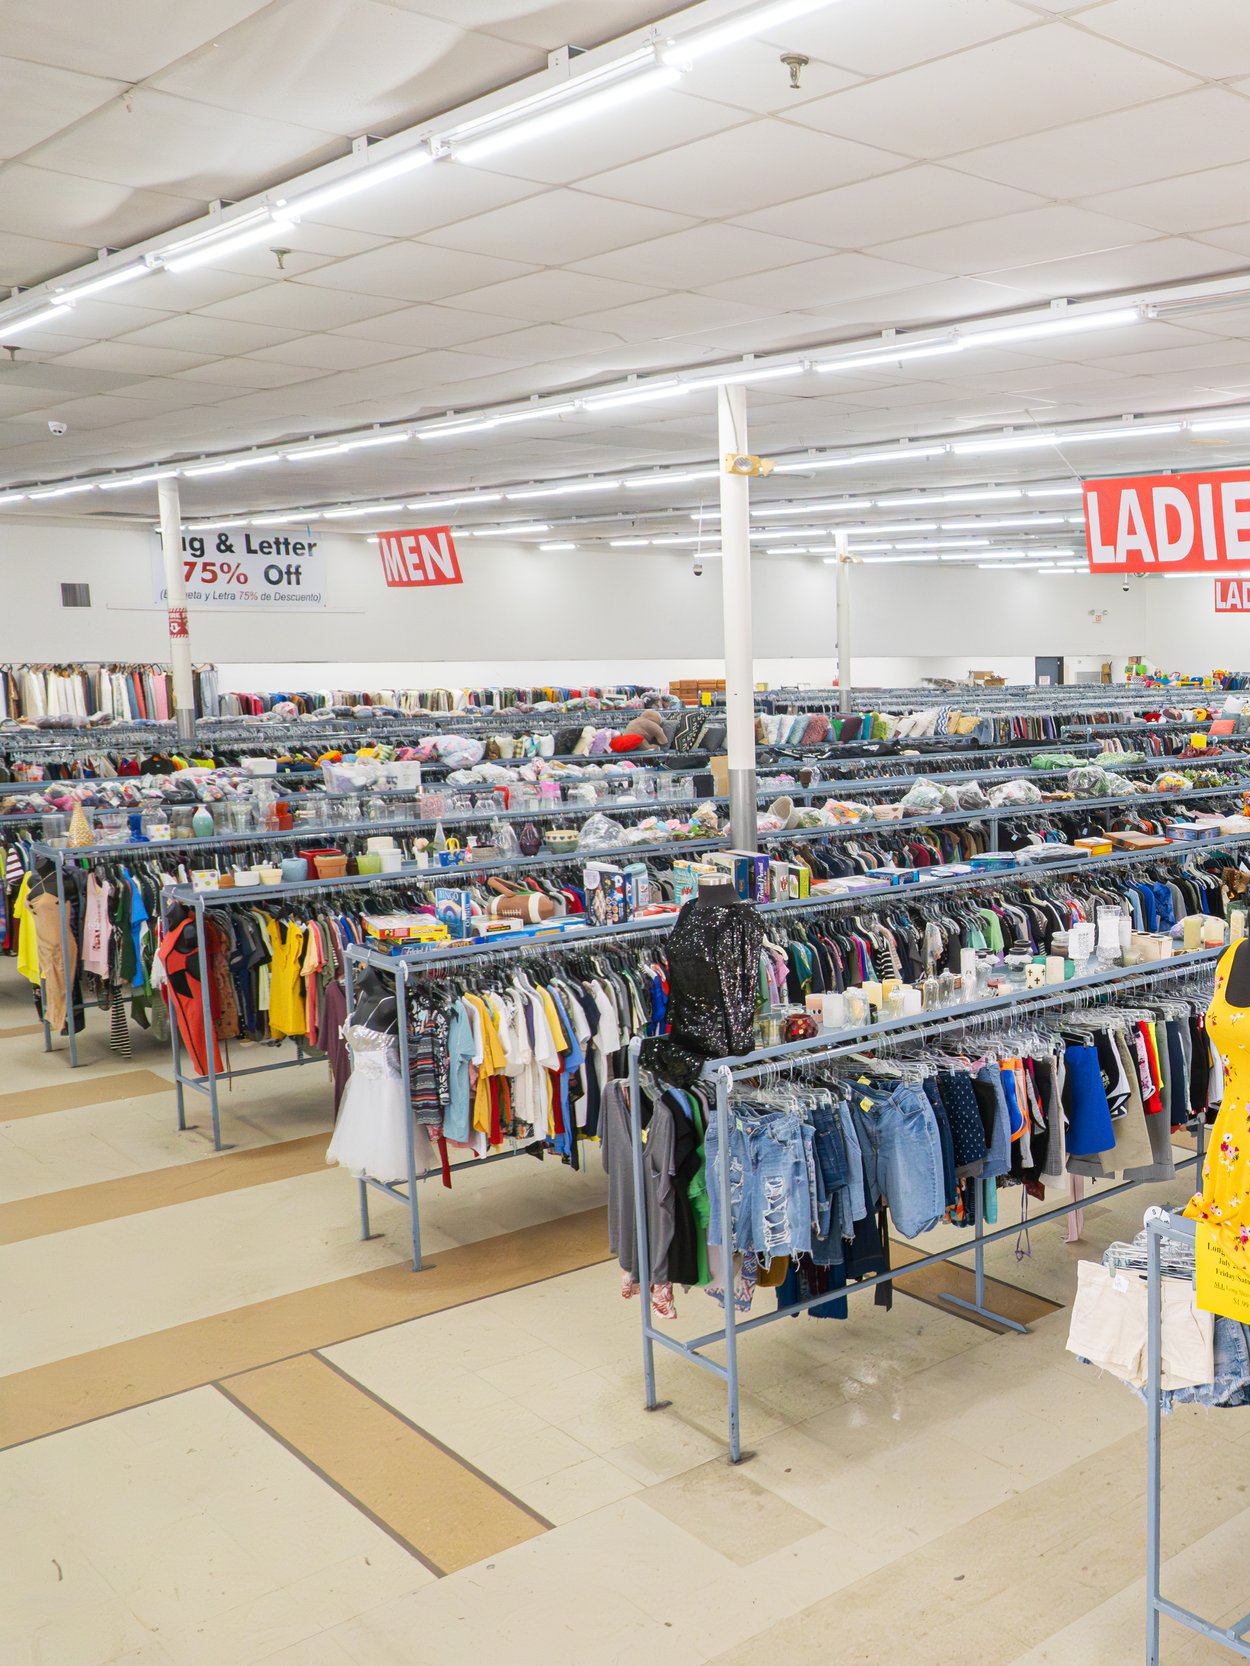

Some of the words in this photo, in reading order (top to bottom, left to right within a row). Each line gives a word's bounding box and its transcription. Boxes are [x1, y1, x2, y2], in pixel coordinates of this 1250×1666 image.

[216, 532, 236, 554] &
[244, 533, 318, 557] Letter
[380, 532, 456, 582] MEN
[183, 561, 249, 585] 75%
[263, 563, 302, 586] Off
[205, 592, 210, 602] y
[212, 590, 236, 600] Letra
[239, 590, 258, 601] 75%
[260, 591, 271, 601] de
[273, 591, 322, 603] Descuento)
